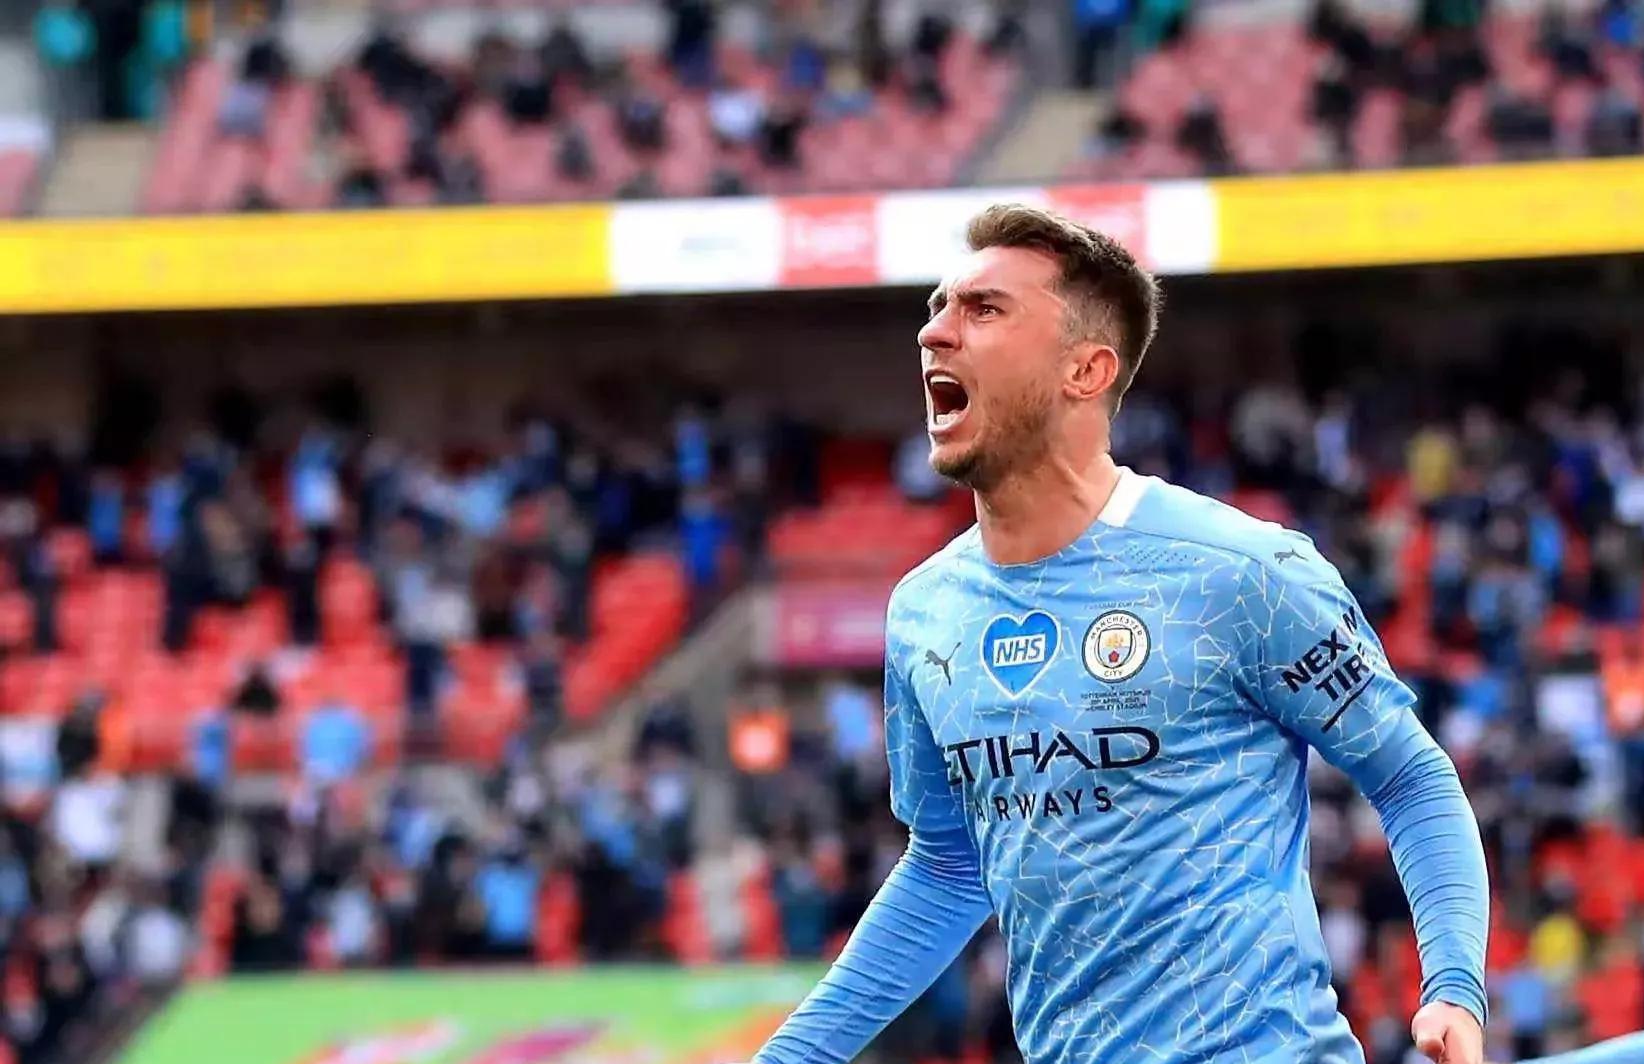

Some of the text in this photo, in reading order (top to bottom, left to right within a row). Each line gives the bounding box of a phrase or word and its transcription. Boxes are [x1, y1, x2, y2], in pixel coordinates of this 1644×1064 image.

[1090, 616, 1143, 639] MANCHESTER
[995, 637, 1042, 664] NHS
[1281, 605, 1358, 694] NEXN
[1103, 667, 1123, 678] CITY
